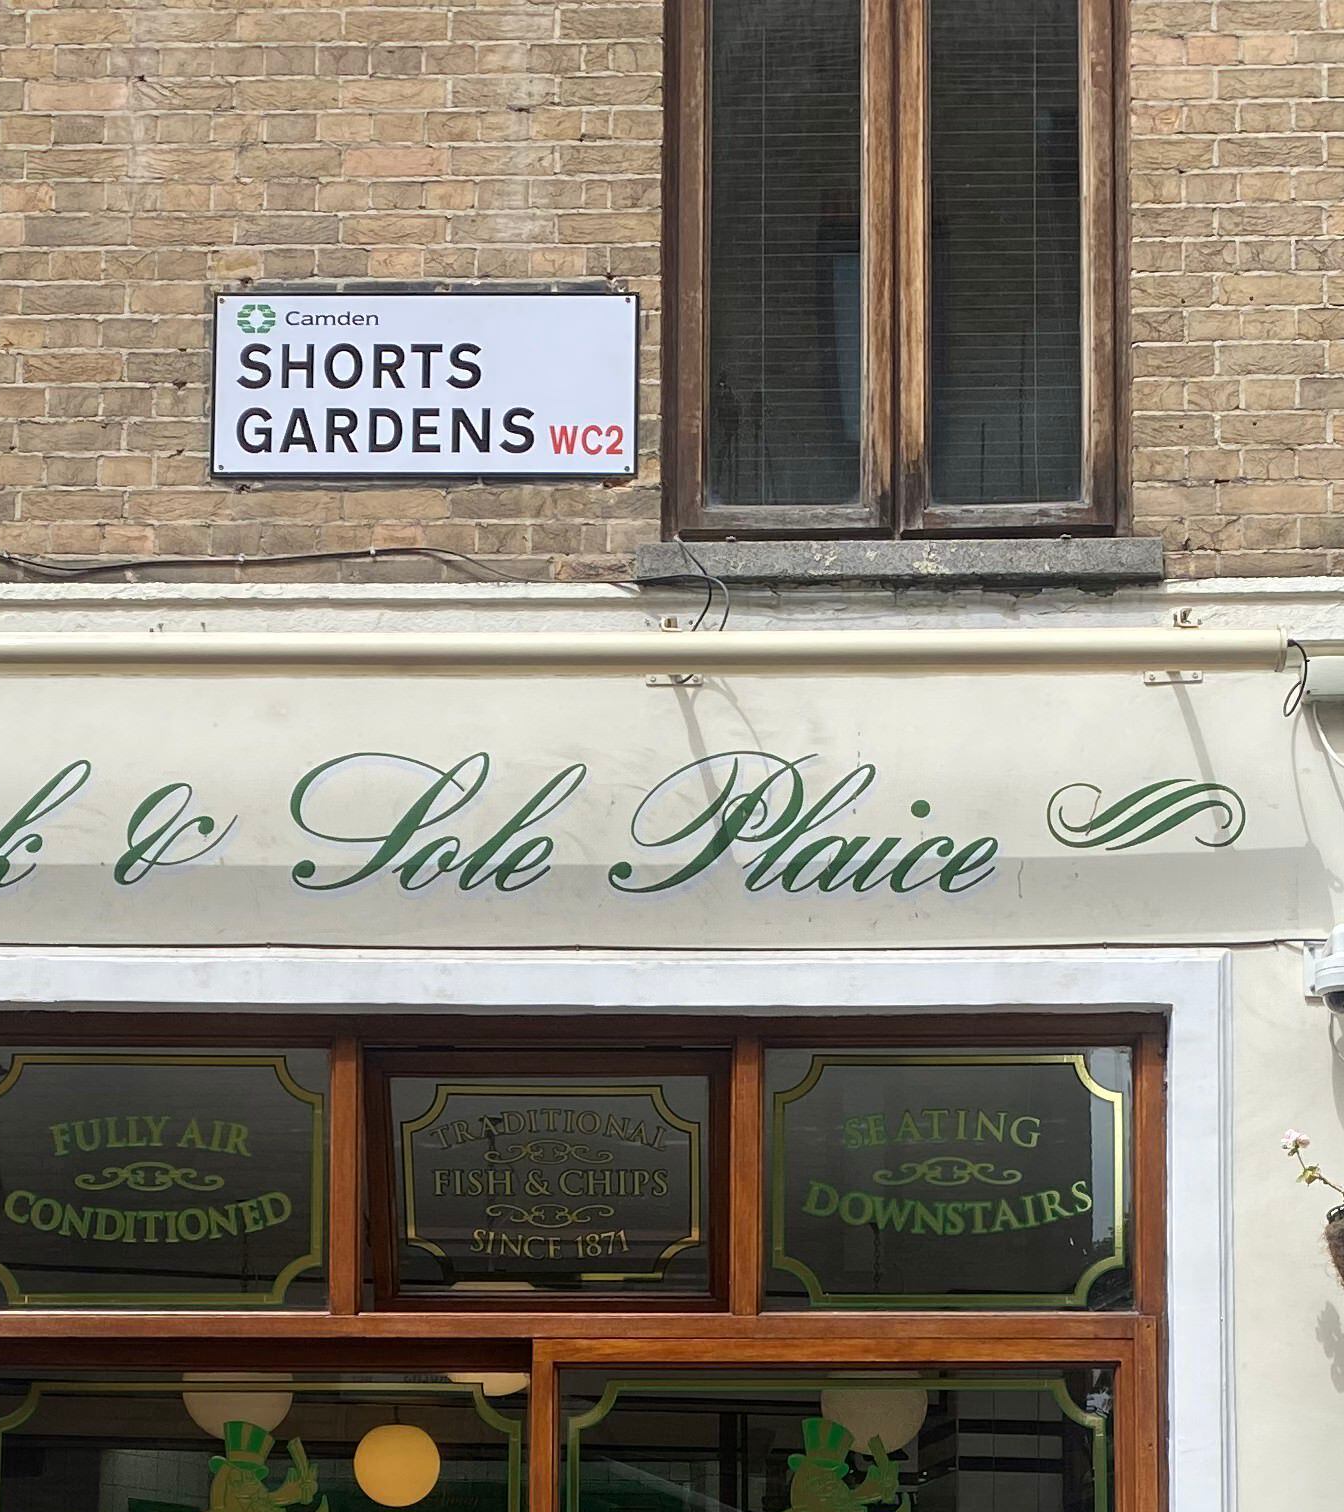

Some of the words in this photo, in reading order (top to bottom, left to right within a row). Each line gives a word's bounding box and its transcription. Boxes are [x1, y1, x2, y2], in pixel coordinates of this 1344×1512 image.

[285, 310, 379, 326] Camden
[236, 342, 482, 389] SHORTS
[236, 407, 535, 453] GARDENS
[550, 424, 623, 455] WC2
[113, 780, 238, 887] &
[290, 751, 587, 892] Sole
[609, 750, 998, 894] Plaice
[49, 1115, 170, 1157] FULLY
[177, 1118, 251, 1157] AIR
[430, 1108, 668, 1150] TRADITIONAL
[844, 1110, 1040, 1149] SEATING
[433, 1170, 512, 1196] FISH
[525, 1170, 552, 1196] &
[559, 1170, 668, 1196] CHIPS
[5, 1190, 292, 1243] CONDITIONED
[802, 1181, 1092, 1235] DOWNSTAIRS
[470, 1229, 561, 1259] SINCE
[575, 1230, 630, 1259] 1871
